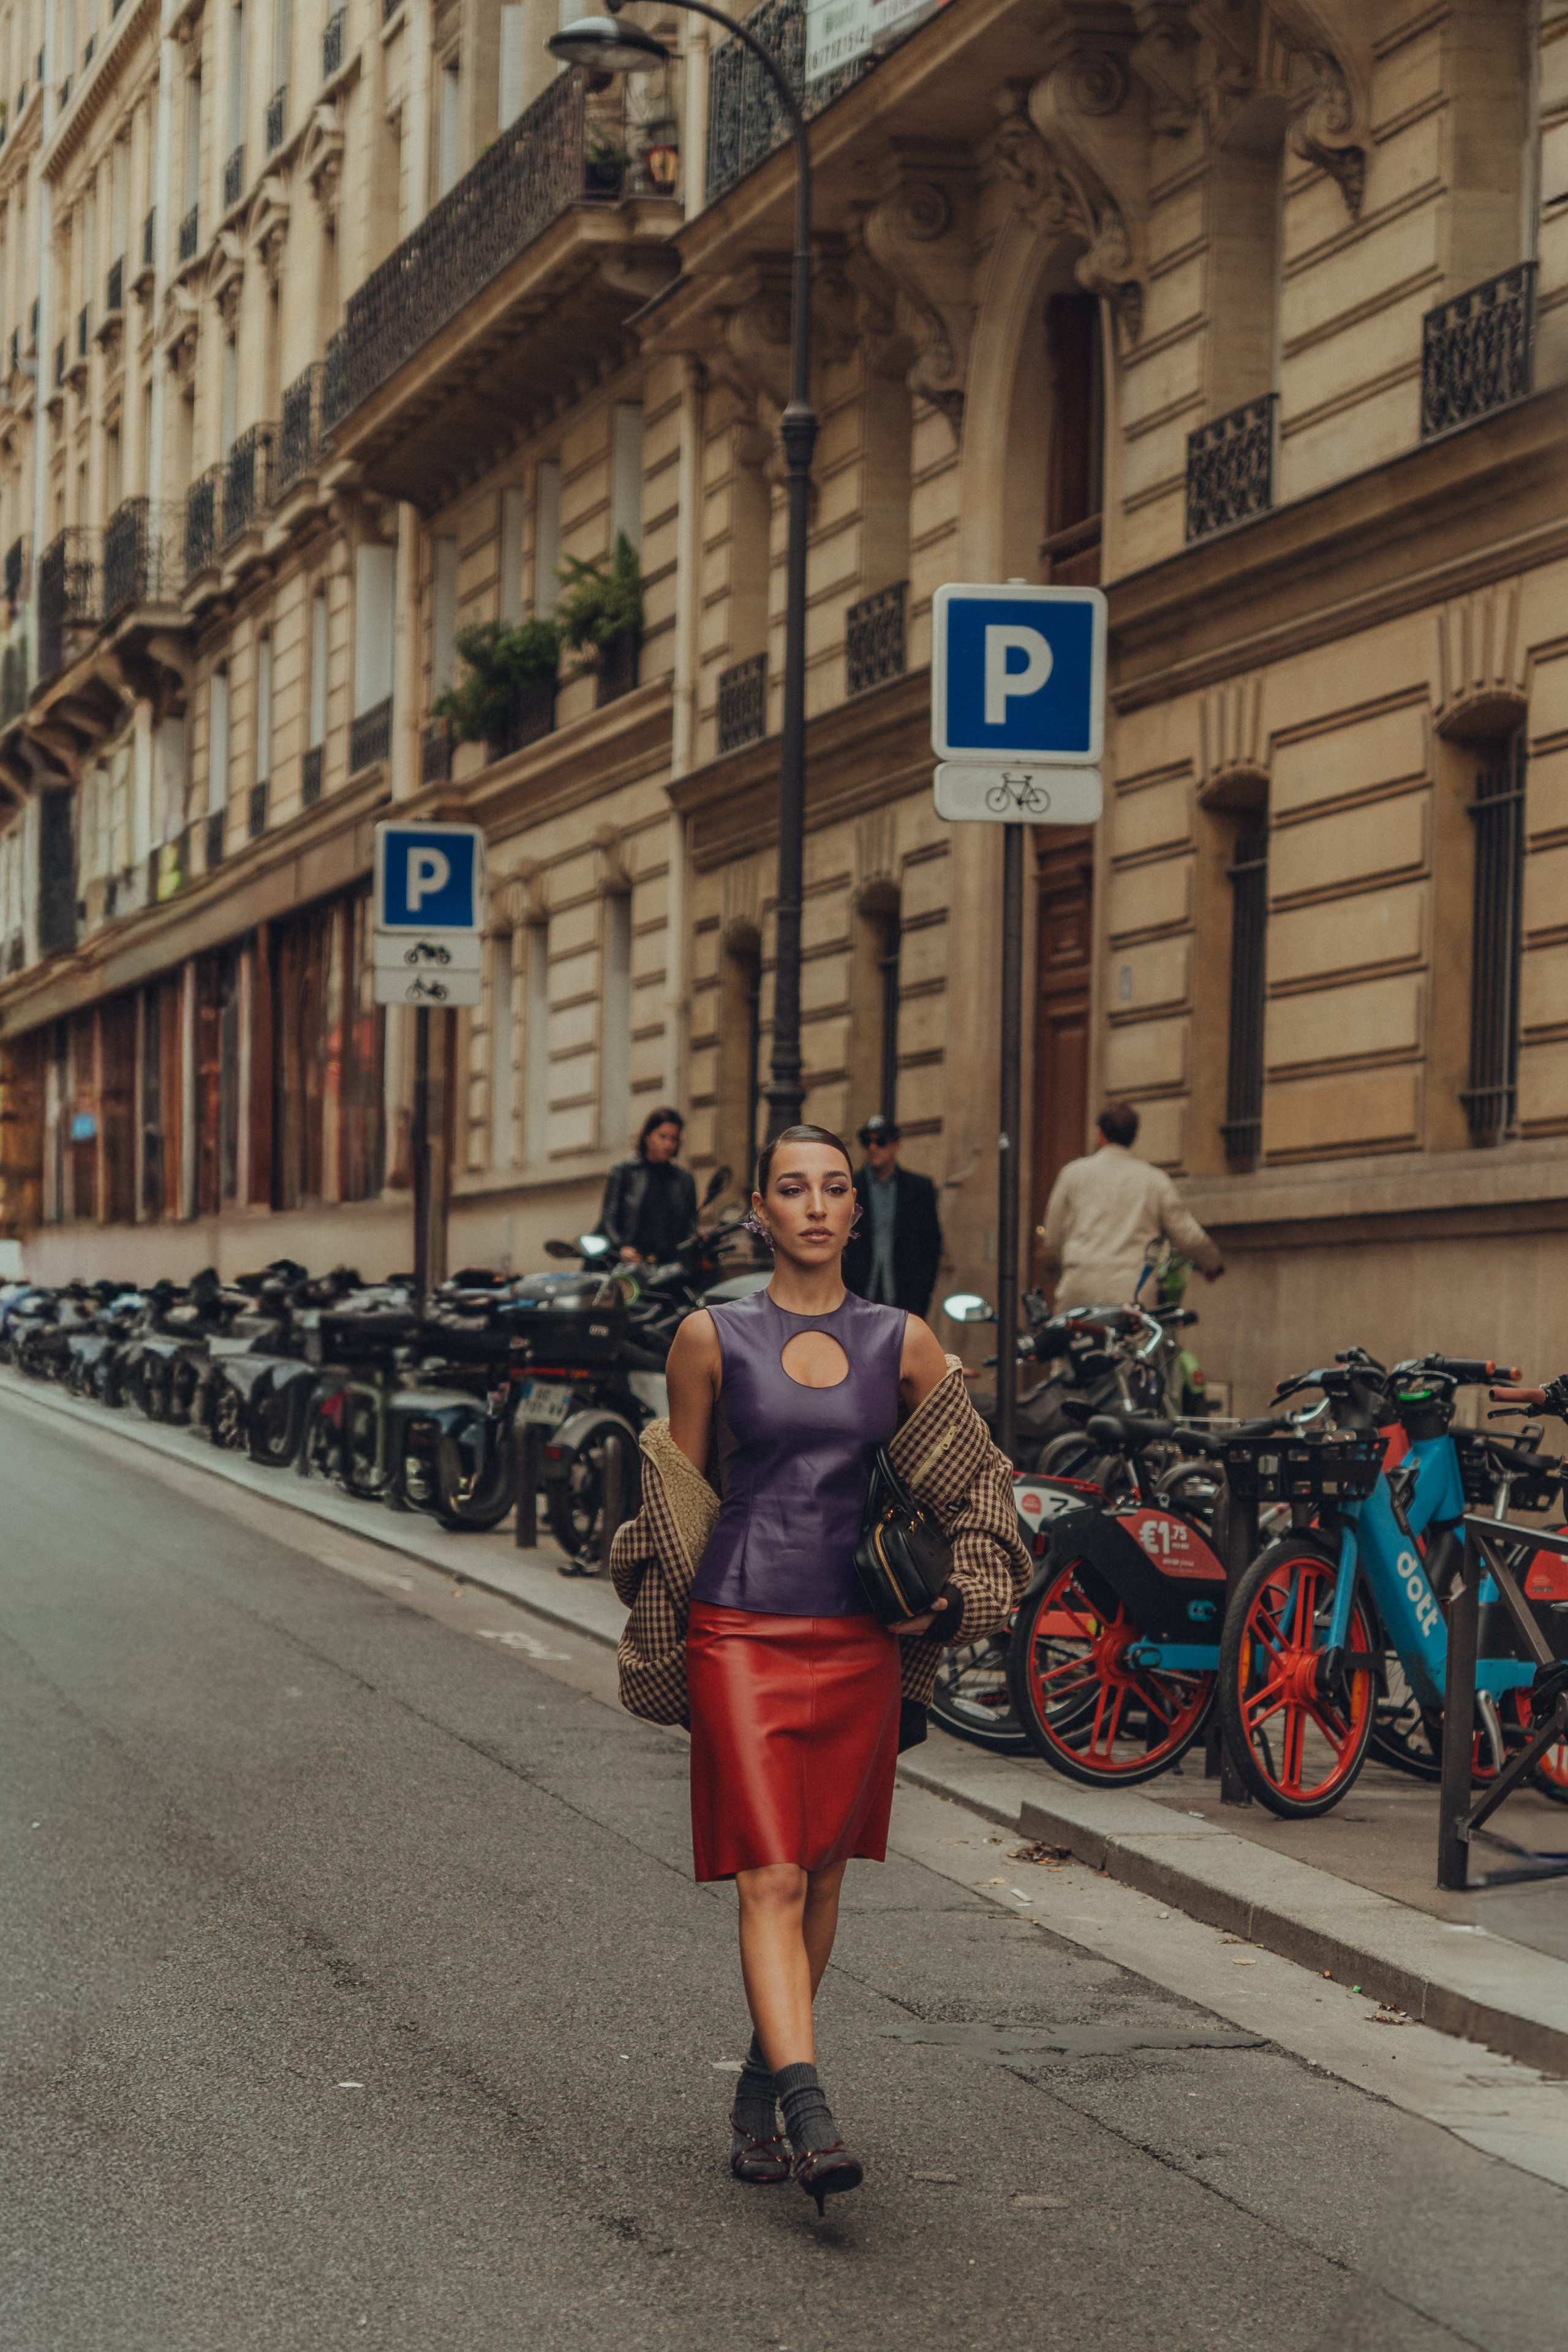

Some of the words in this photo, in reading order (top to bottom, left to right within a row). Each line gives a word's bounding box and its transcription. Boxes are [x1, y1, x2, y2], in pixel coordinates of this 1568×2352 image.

[984, 624, 1054, 725] P
[406, 846, 451, 912] P
[1396, 1551, 1439, 1638] dott
